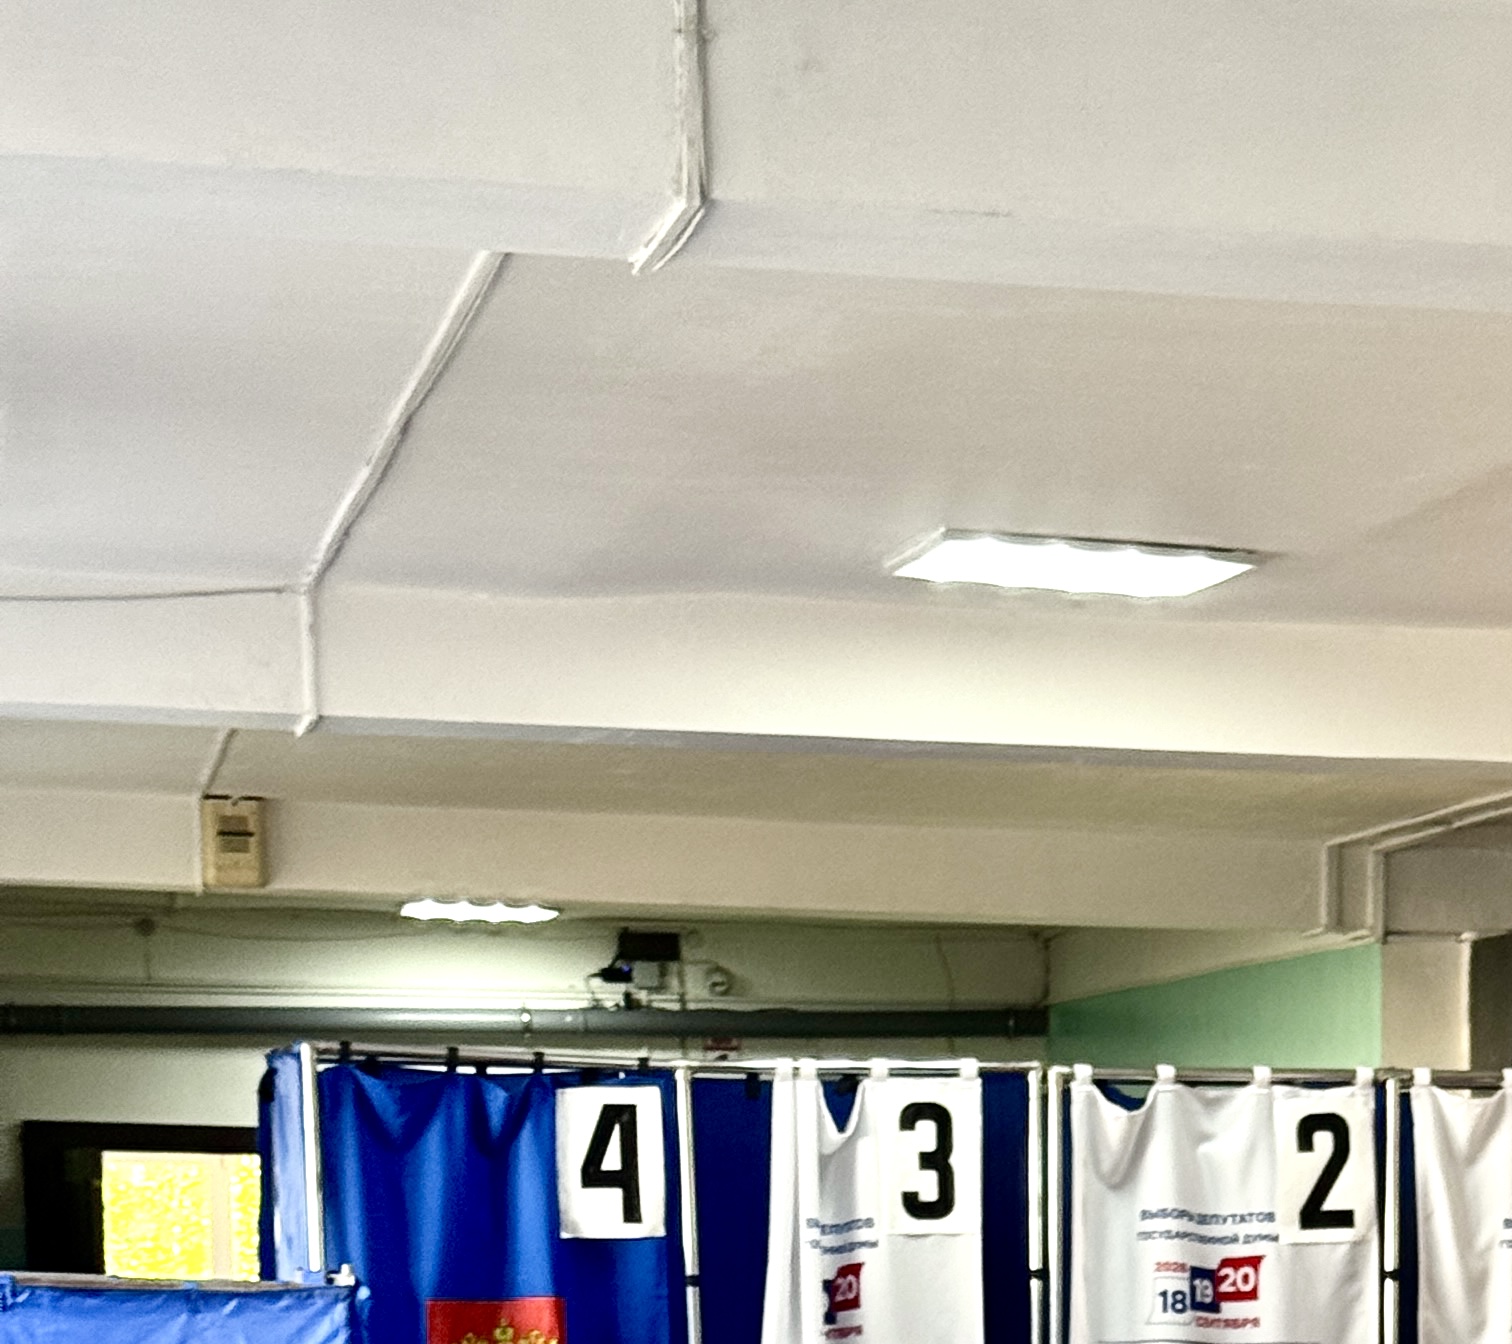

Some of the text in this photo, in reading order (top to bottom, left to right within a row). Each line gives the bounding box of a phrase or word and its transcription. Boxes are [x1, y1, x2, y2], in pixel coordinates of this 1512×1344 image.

[580, 1102, 643, 1224] 4
[899, 1102, 956, 1221] 3
[1296, 1112, 1354, 1230] 2
[834, 1273, 858, 1303] 20
[1157, 1265, 1257, 1314] 18 19 20
